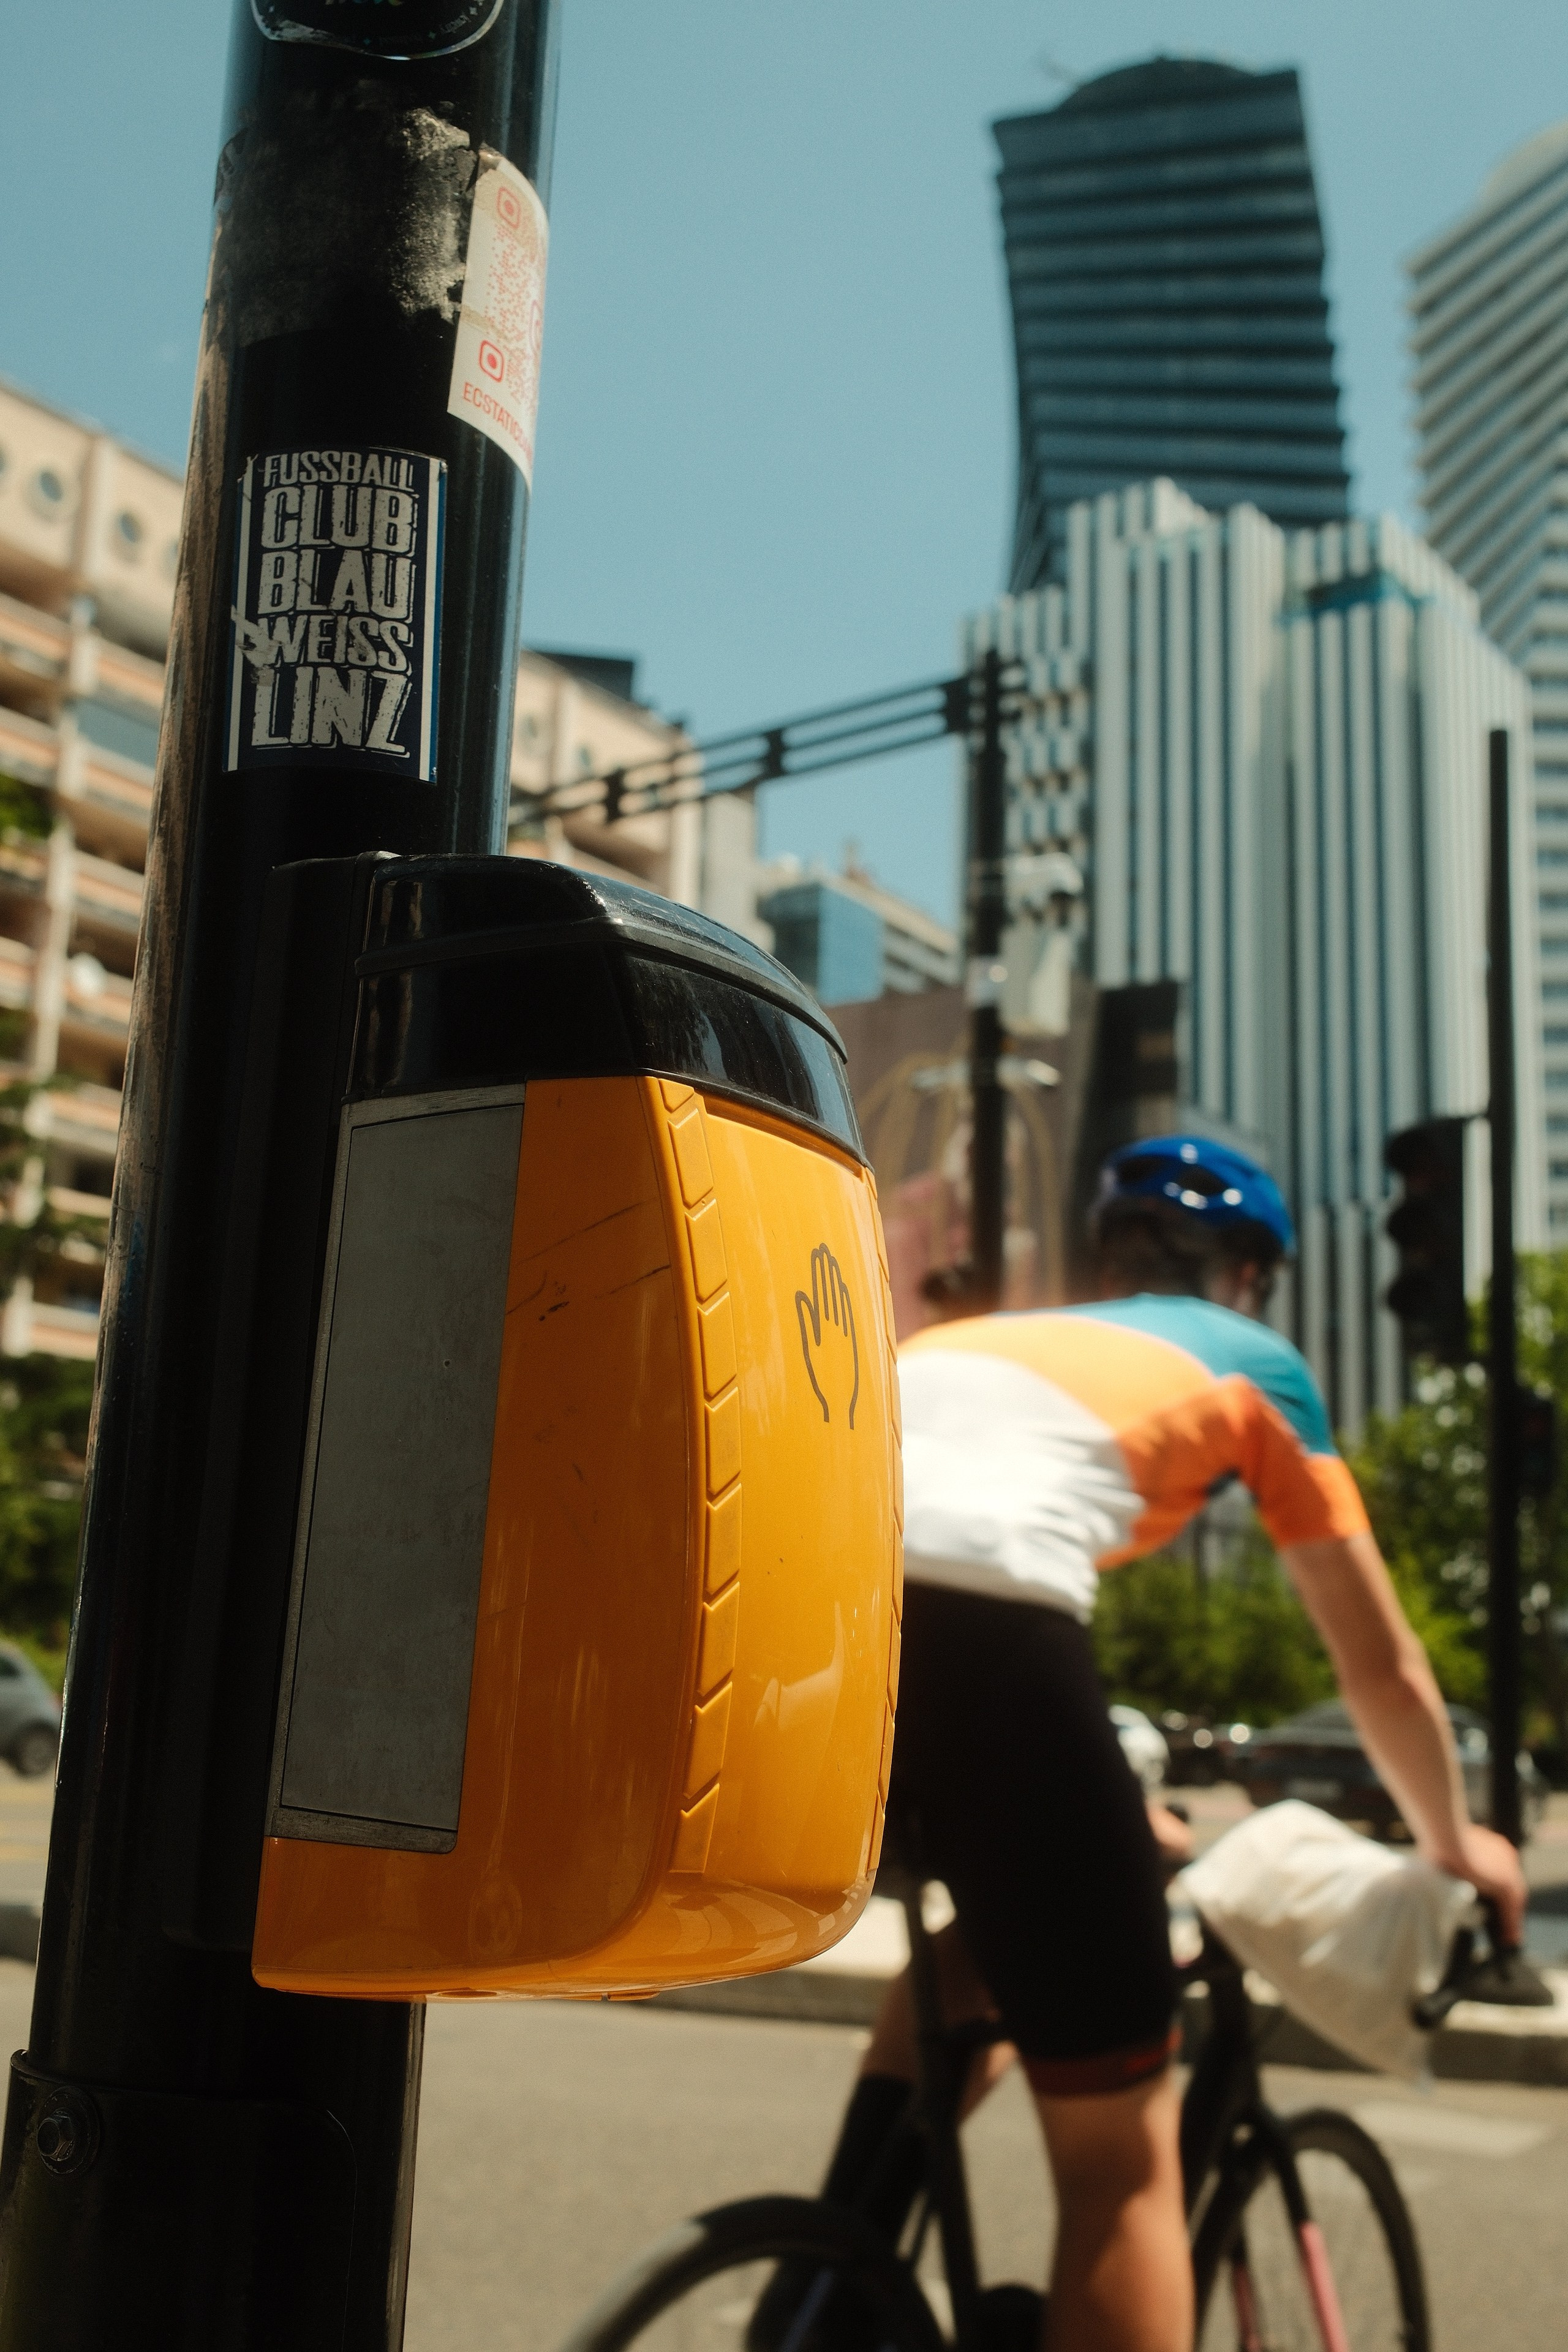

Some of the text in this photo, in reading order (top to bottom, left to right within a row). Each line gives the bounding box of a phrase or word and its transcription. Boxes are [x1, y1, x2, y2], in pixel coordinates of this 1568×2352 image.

[263, 451, 414, 492] FUSSBALL
[261, 484, 418, 556] CLUB
[257, 549, 417, 621] BLAU
[256, 614, 413, 675] WEISS
[251, 666, 411, 757] LINZ
